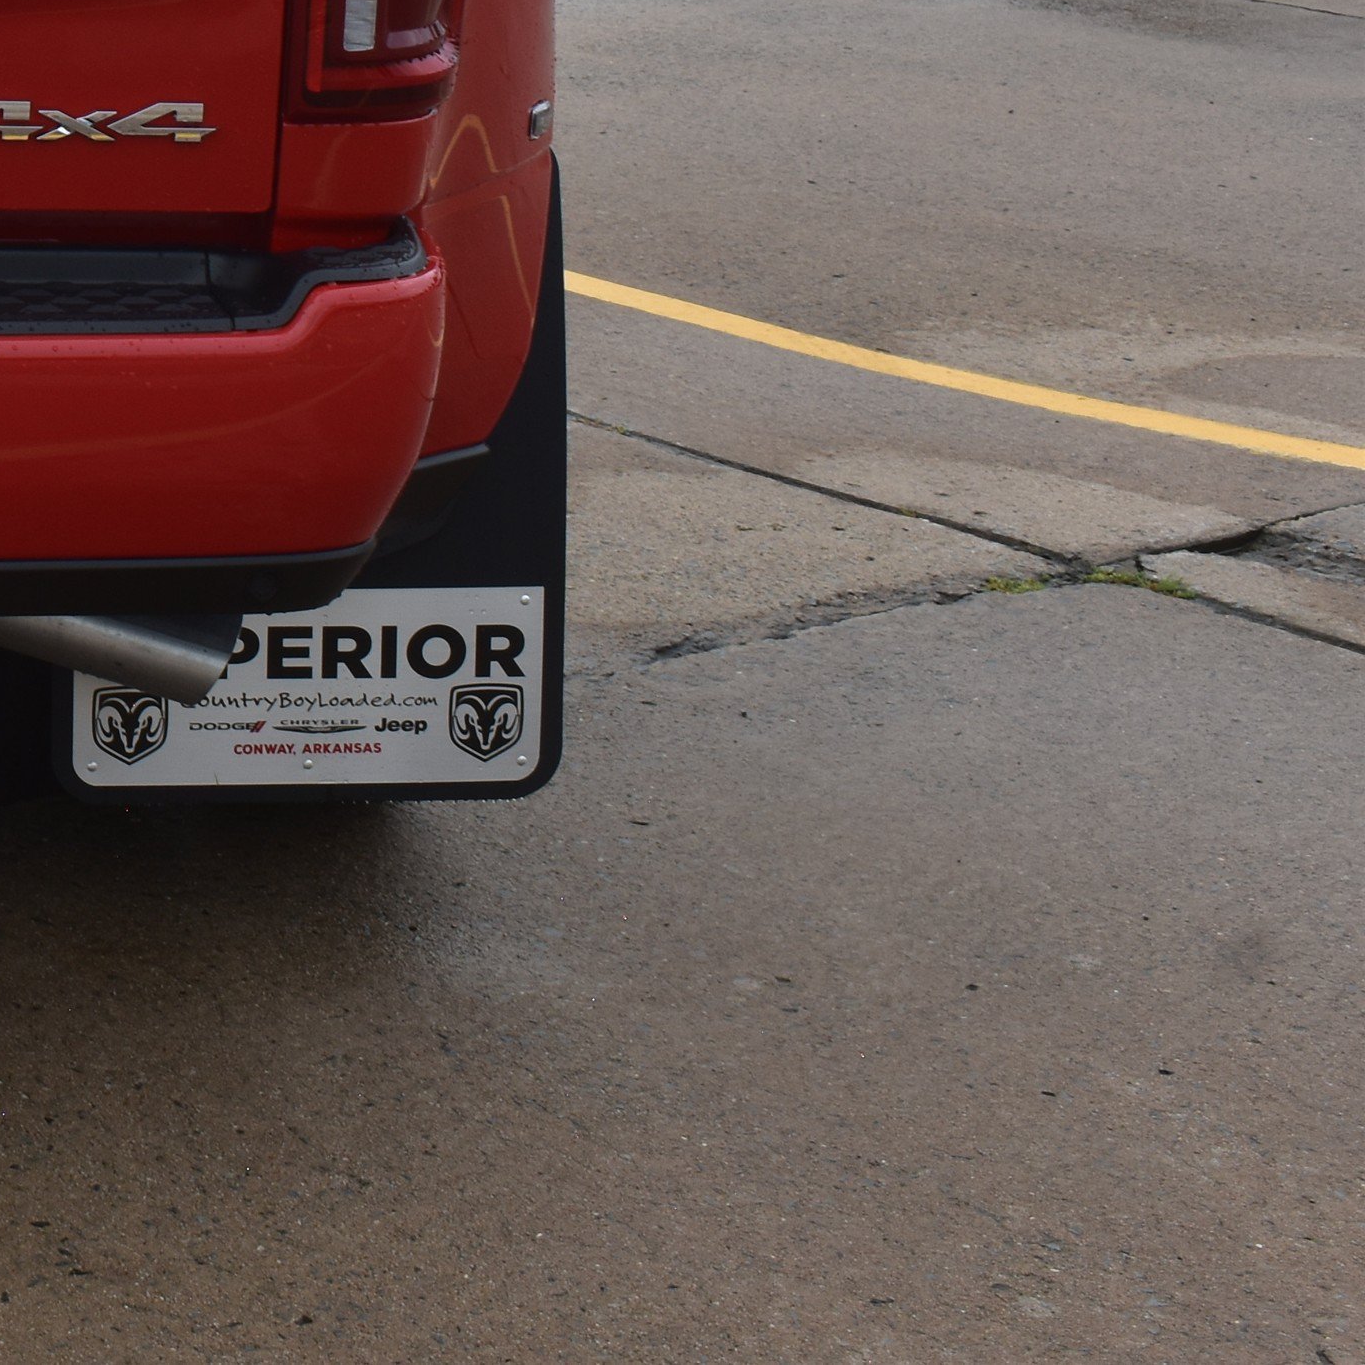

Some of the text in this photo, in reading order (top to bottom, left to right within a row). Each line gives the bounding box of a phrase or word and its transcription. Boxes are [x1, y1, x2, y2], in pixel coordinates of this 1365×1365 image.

[219, 624, 526, 679] PERIOR
[189, 722, 256, 731] DODGE
[374, 717, 428, 735] Jeep
[234, 742, 382, 756] CONWAY, ARKANSAS
